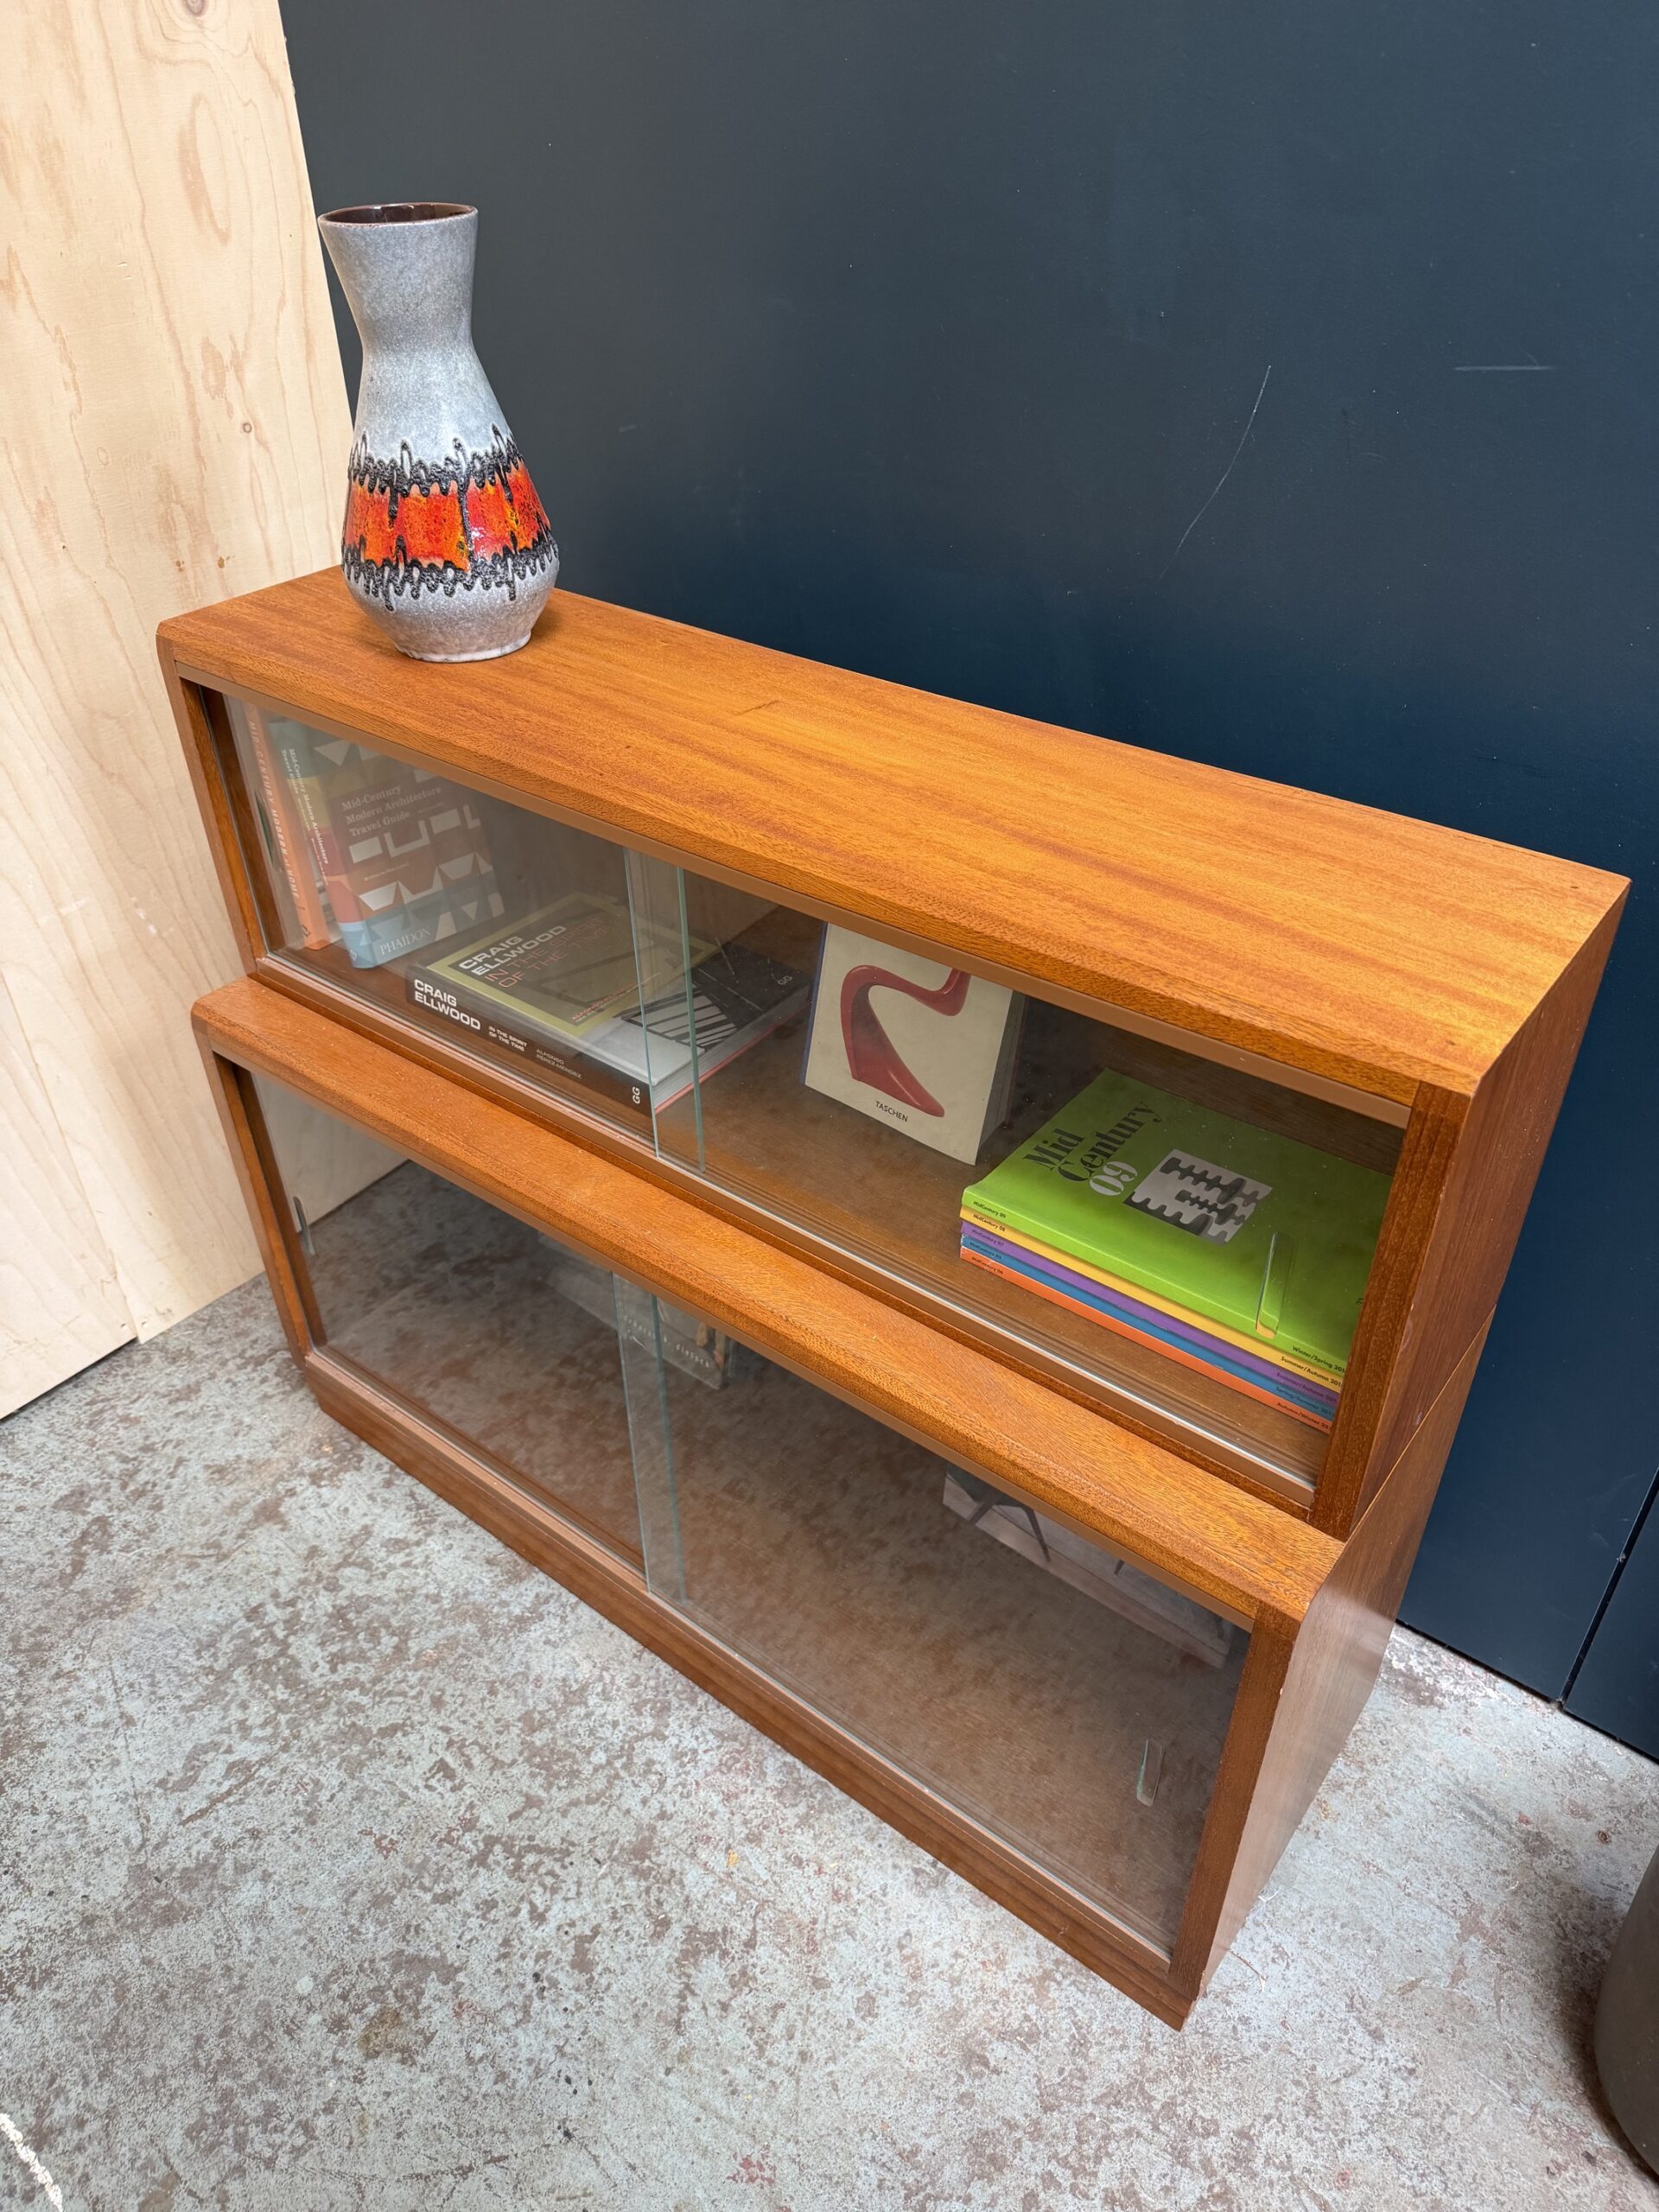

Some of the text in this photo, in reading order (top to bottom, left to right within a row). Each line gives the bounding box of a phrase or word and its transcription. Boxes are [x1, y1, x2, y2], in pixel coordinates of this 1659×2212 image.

[341, 785, 402, 810] Mid-Century
[346, 805, 383, 824] Modern
[385, 787, 442, 811] Architecture
[270, 808, 288, 856] MODERN
[349, 810, 410, 836] Travel Guide
[312, 822, 329, 864] Architecture
[379, 927, 430, 955] PHAIDON
[458, 936, 524, 969] CRAIG
[471, 925, 567, 976] ELLWOOD
[485, 969, 508, 982] IN
[510, 947, 547, 968] THE
[498, 972, 525, 988] OF
[527, 951, 568, 970] THE
[414, 978, 457, 1007] CRAIG
[778, 975, 793, 986] GG
[414, 990, 480, 1030] ELLWOOD
[496, 1028, 509, 1038] THE
[499, 1035, 510, 1045] THE
[632, 1086, 641, 1104] GG
[874, 1100, 908, 1122] TASCHEN
[1023, 1128, 1085, 1171] Mid
[1058, 1101, 1161, 1182] Century
[1090, 1160, 1138, 1196] 09
[973, 1200, 999, 1216] MidCentury
[973, 1213, 998, 1229] MidCentury
[971, 1229, 997, 1244] MidCentury
[971, 1256, 996, 1272] MidCentury
[1281, 1356, 1341, 1387] Summer/Autumn 201
[1292, 1344, 1345, 1373] Winter/Spring 201
[1276, 1402, 1320, 1425] Autumn/Winter
